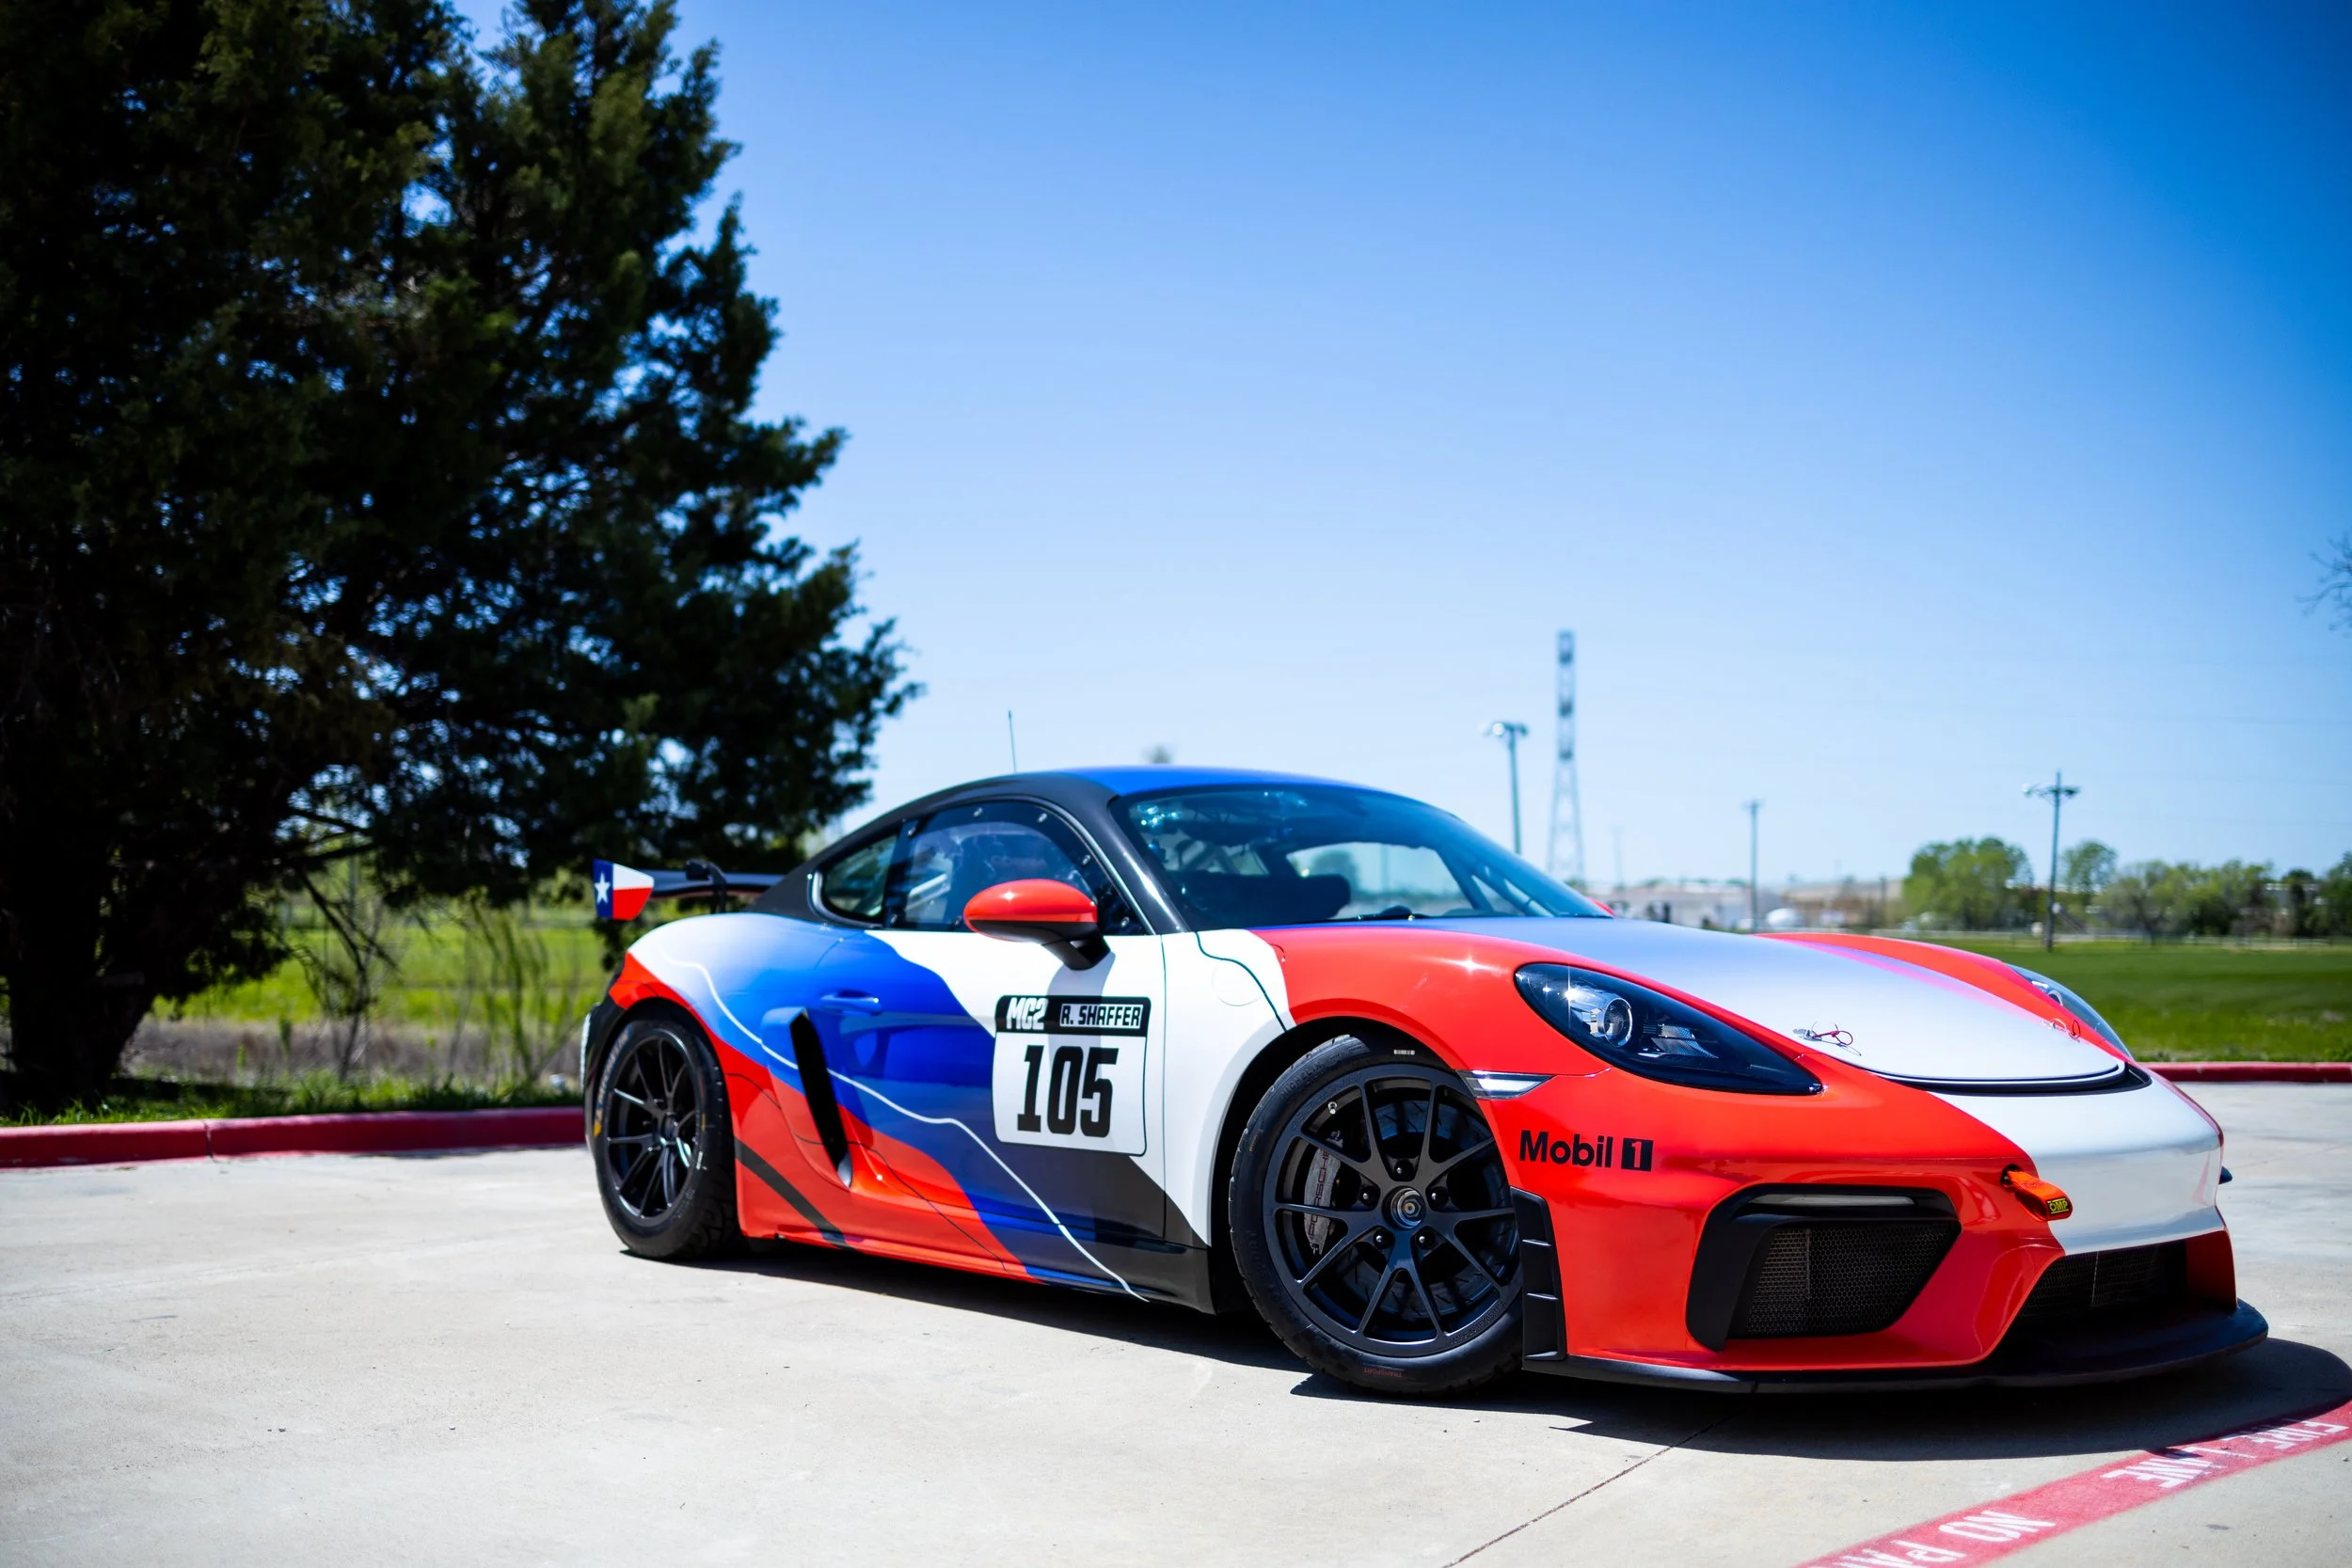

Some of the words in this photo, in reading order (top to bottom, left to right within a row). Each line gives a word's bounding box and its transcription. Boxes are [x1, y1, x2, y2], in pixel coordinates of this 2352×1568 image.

[1006, 997, 1049, 1031] MC2
[1060, 1005, 1074, 1025] R.
[1078, 1005, 1141, 1027] SHAFFER
[1017, 1044, 1120, 1138] 105
[1519, 1130, 1613, 1168] Mobil
[2049, 1199, 2069, 1212] OMP
[2220, 1418, 2350, 1450] FIRE
[2099, 1446, 2258, 1488] LANE
[1938, 1510, 2058, 1542] NO
